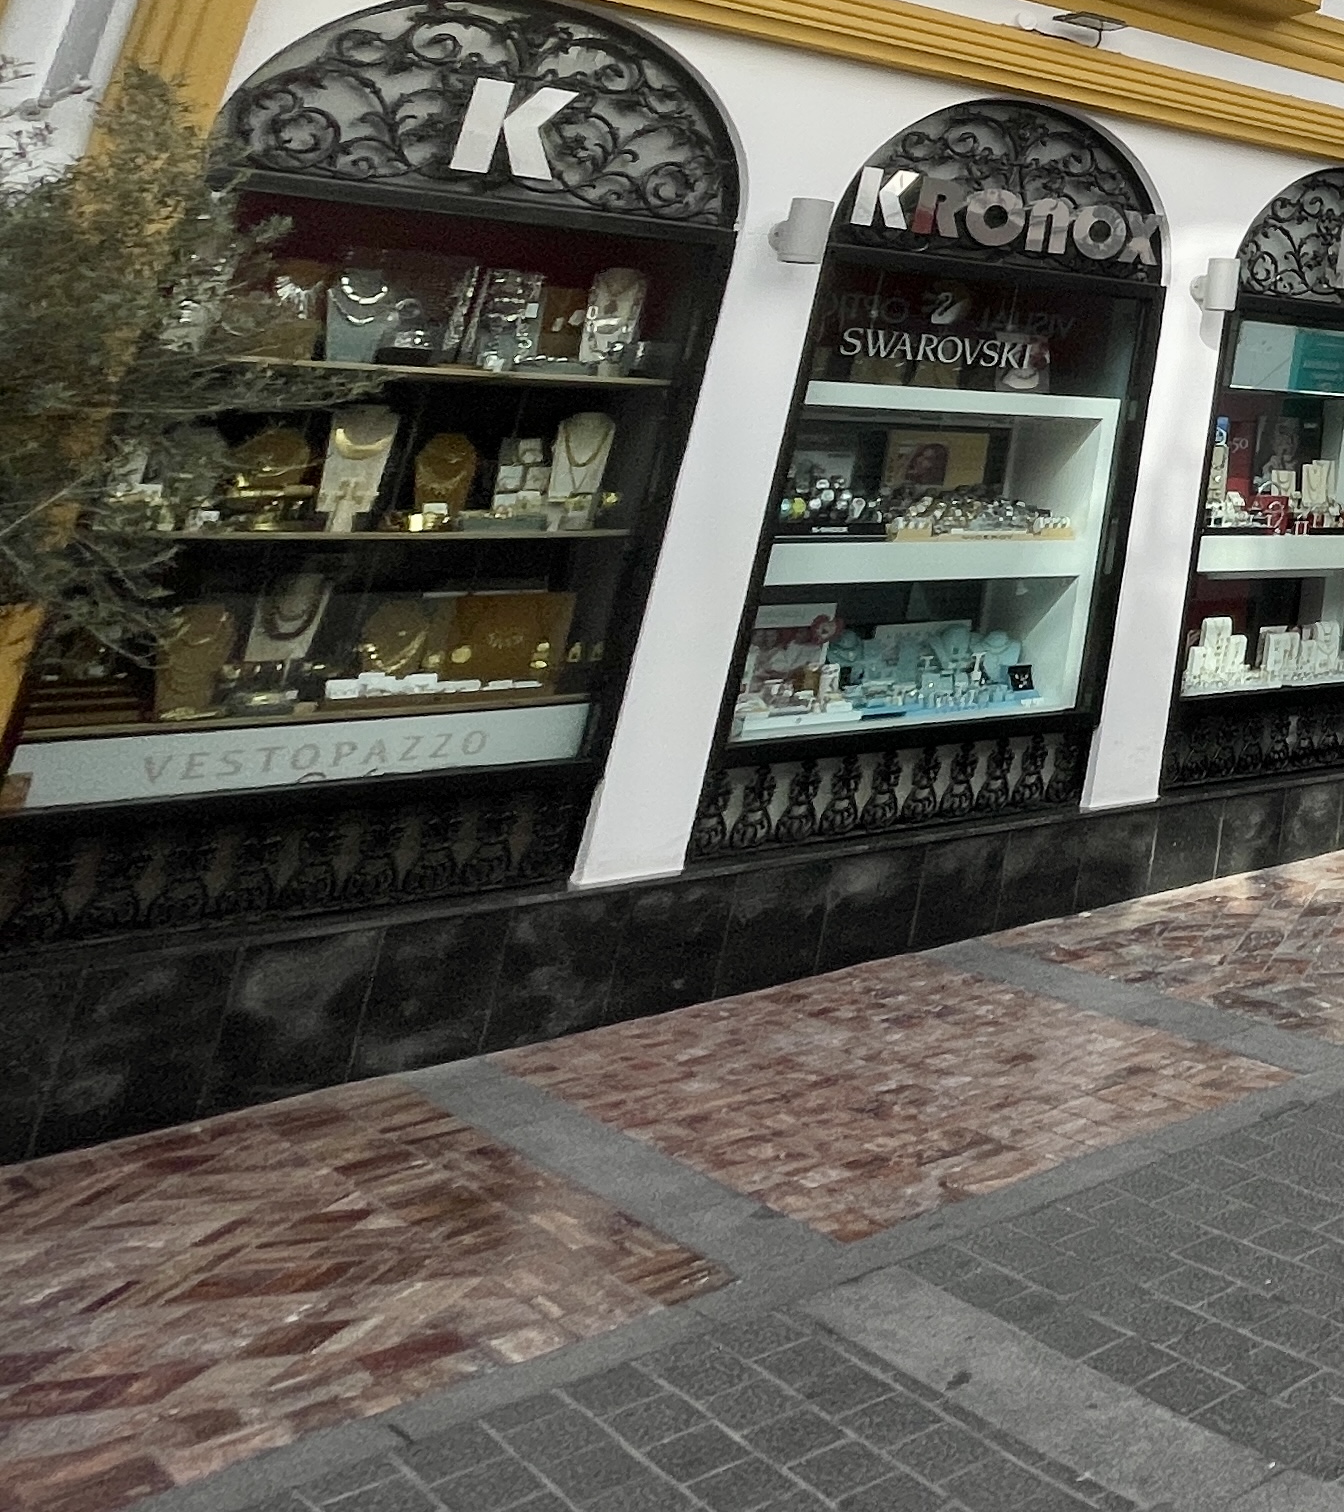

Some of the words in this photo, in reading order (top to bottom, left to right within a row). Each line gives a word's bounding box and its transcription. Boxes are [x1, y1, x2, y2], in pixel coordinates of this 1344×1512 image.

[449, 77, 580, 180] K
[839, 327, 1034, 370] SWAROVSKI
[144, 729, 489, 784] VESTOPAZZO
